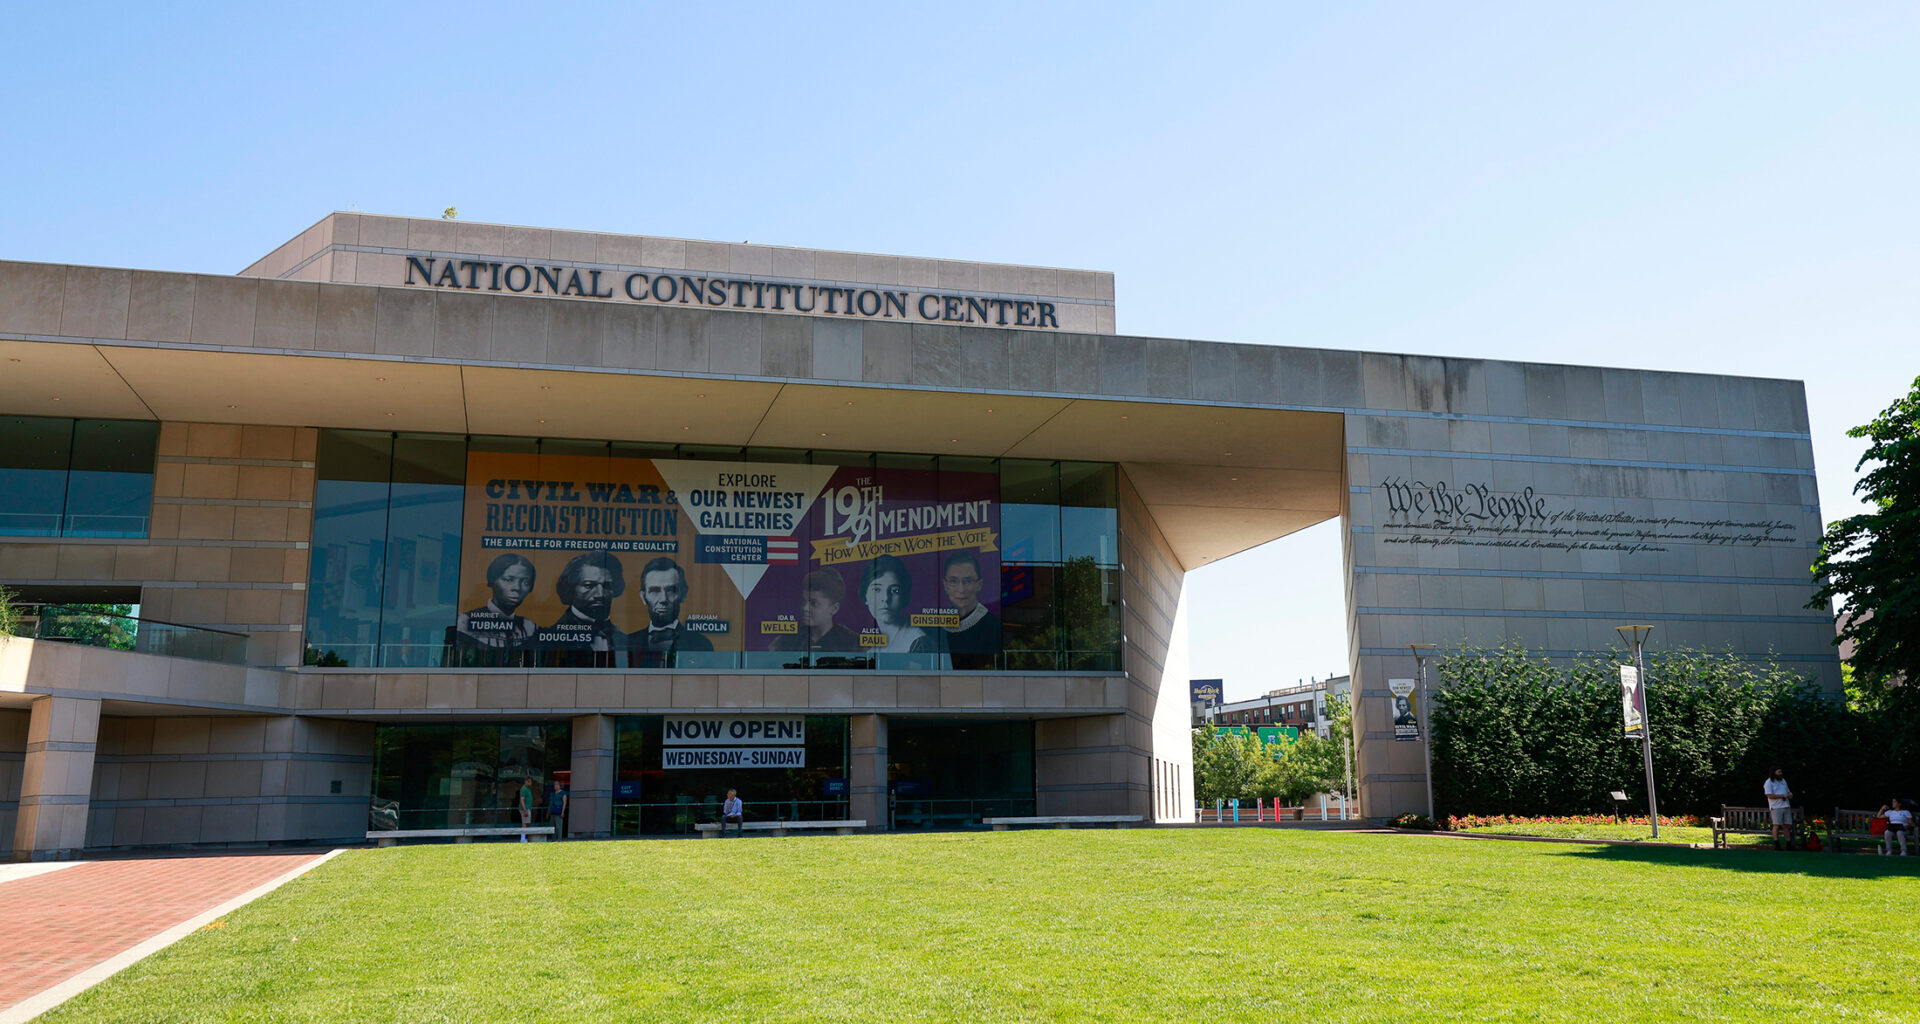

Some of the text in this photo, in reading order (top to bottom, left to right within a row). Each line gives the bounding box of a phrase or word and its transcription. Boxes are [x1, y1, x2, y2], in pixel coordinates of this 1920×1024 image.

[404, 257, 1059, 328] NATIONAL CONSTITUTION CENTER
[718, 473, 777, 488] EXPLORE
[856, 477, 872, 486] THE
[486, 479, 678, 505] CIVIL WAR &
[690, 489, 804, 510] OUR NEWEST
[1380, 476, 1430, 519] We
[1414, 481, 1470, 520] the
[1463, 482, 1552, 528] People
[1550, 510, 1564, 525] of
[821, 485, 883, 537] 19TH
[485, 503, 678, 536] RECONSTRUCTION
[700, 511, 794, 530] GALLERIES
[845, 500, 991, 547] AMENDMENT
[484, 537, 677, 552] THE BATTLE FOR FREEDOM AND EQUALITY
[705, 545, 762, 554] CONSTITUTION
[723, 538, 762, 546] NATIONAL
[731, 553, 762, 561] CENTER
[825, 547, 853, 562] HOW
[470, 621, 513, 631] TUBMAN
[687, 622, 727, 632] LINCOLN
[763, 622, 796, 632] WELLS
[912, 615, 959, 625] GINSBURG
[539, 632, 592, 642] DOUGLASS
[862, 635, 886, 646] PAUL
[666, 720, 802, 739] NOW OPEN!
